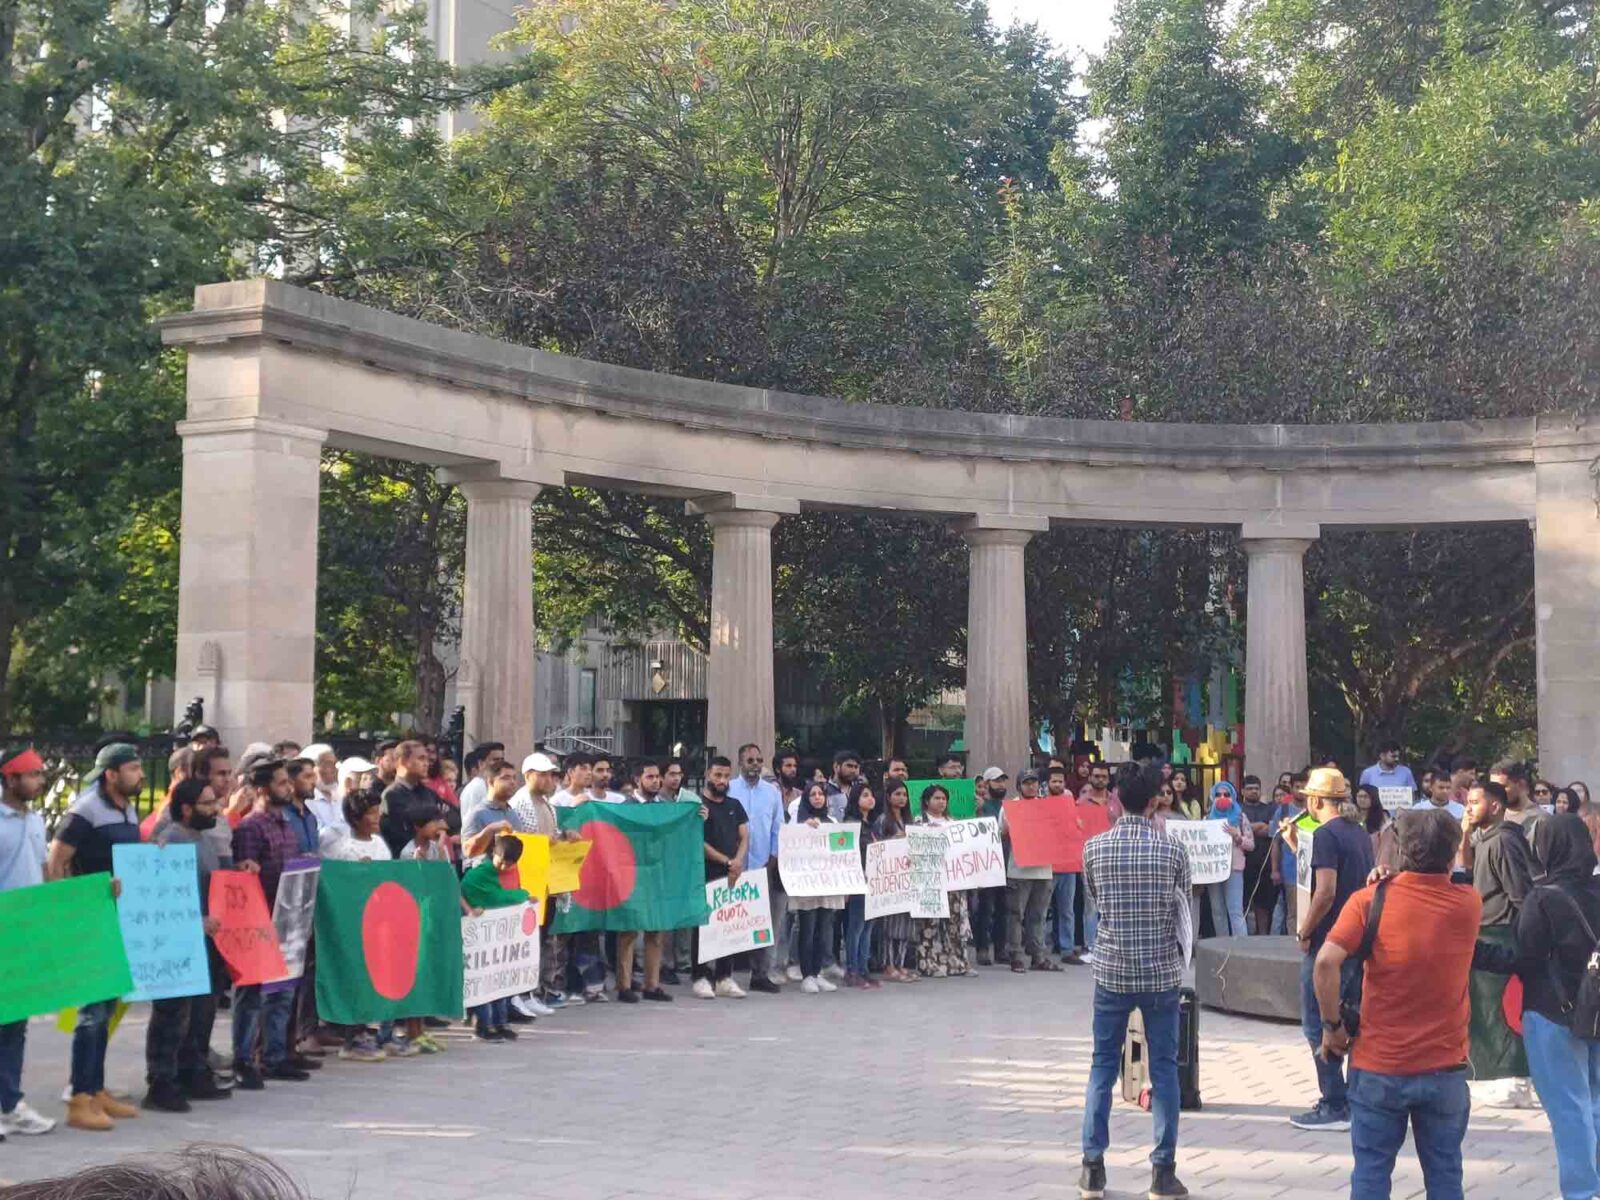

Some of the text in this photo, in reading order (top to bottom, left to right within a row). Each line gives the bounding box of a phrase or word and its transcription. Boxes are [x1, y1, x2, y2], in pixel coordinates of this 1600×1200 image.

[869, 843, 885, 862] STOP
[877, 855, 911, 875] KILLING
[946, 848, 1002, 882] HASINA
[713, 881, 760, 910] REFORM
[869, 871, 911, 896] STUDENTS
[717, 903, 748, 922] QUOTA
[463, 914, 521, 947] STOP
[463, 941, 530, 970] KILLING
